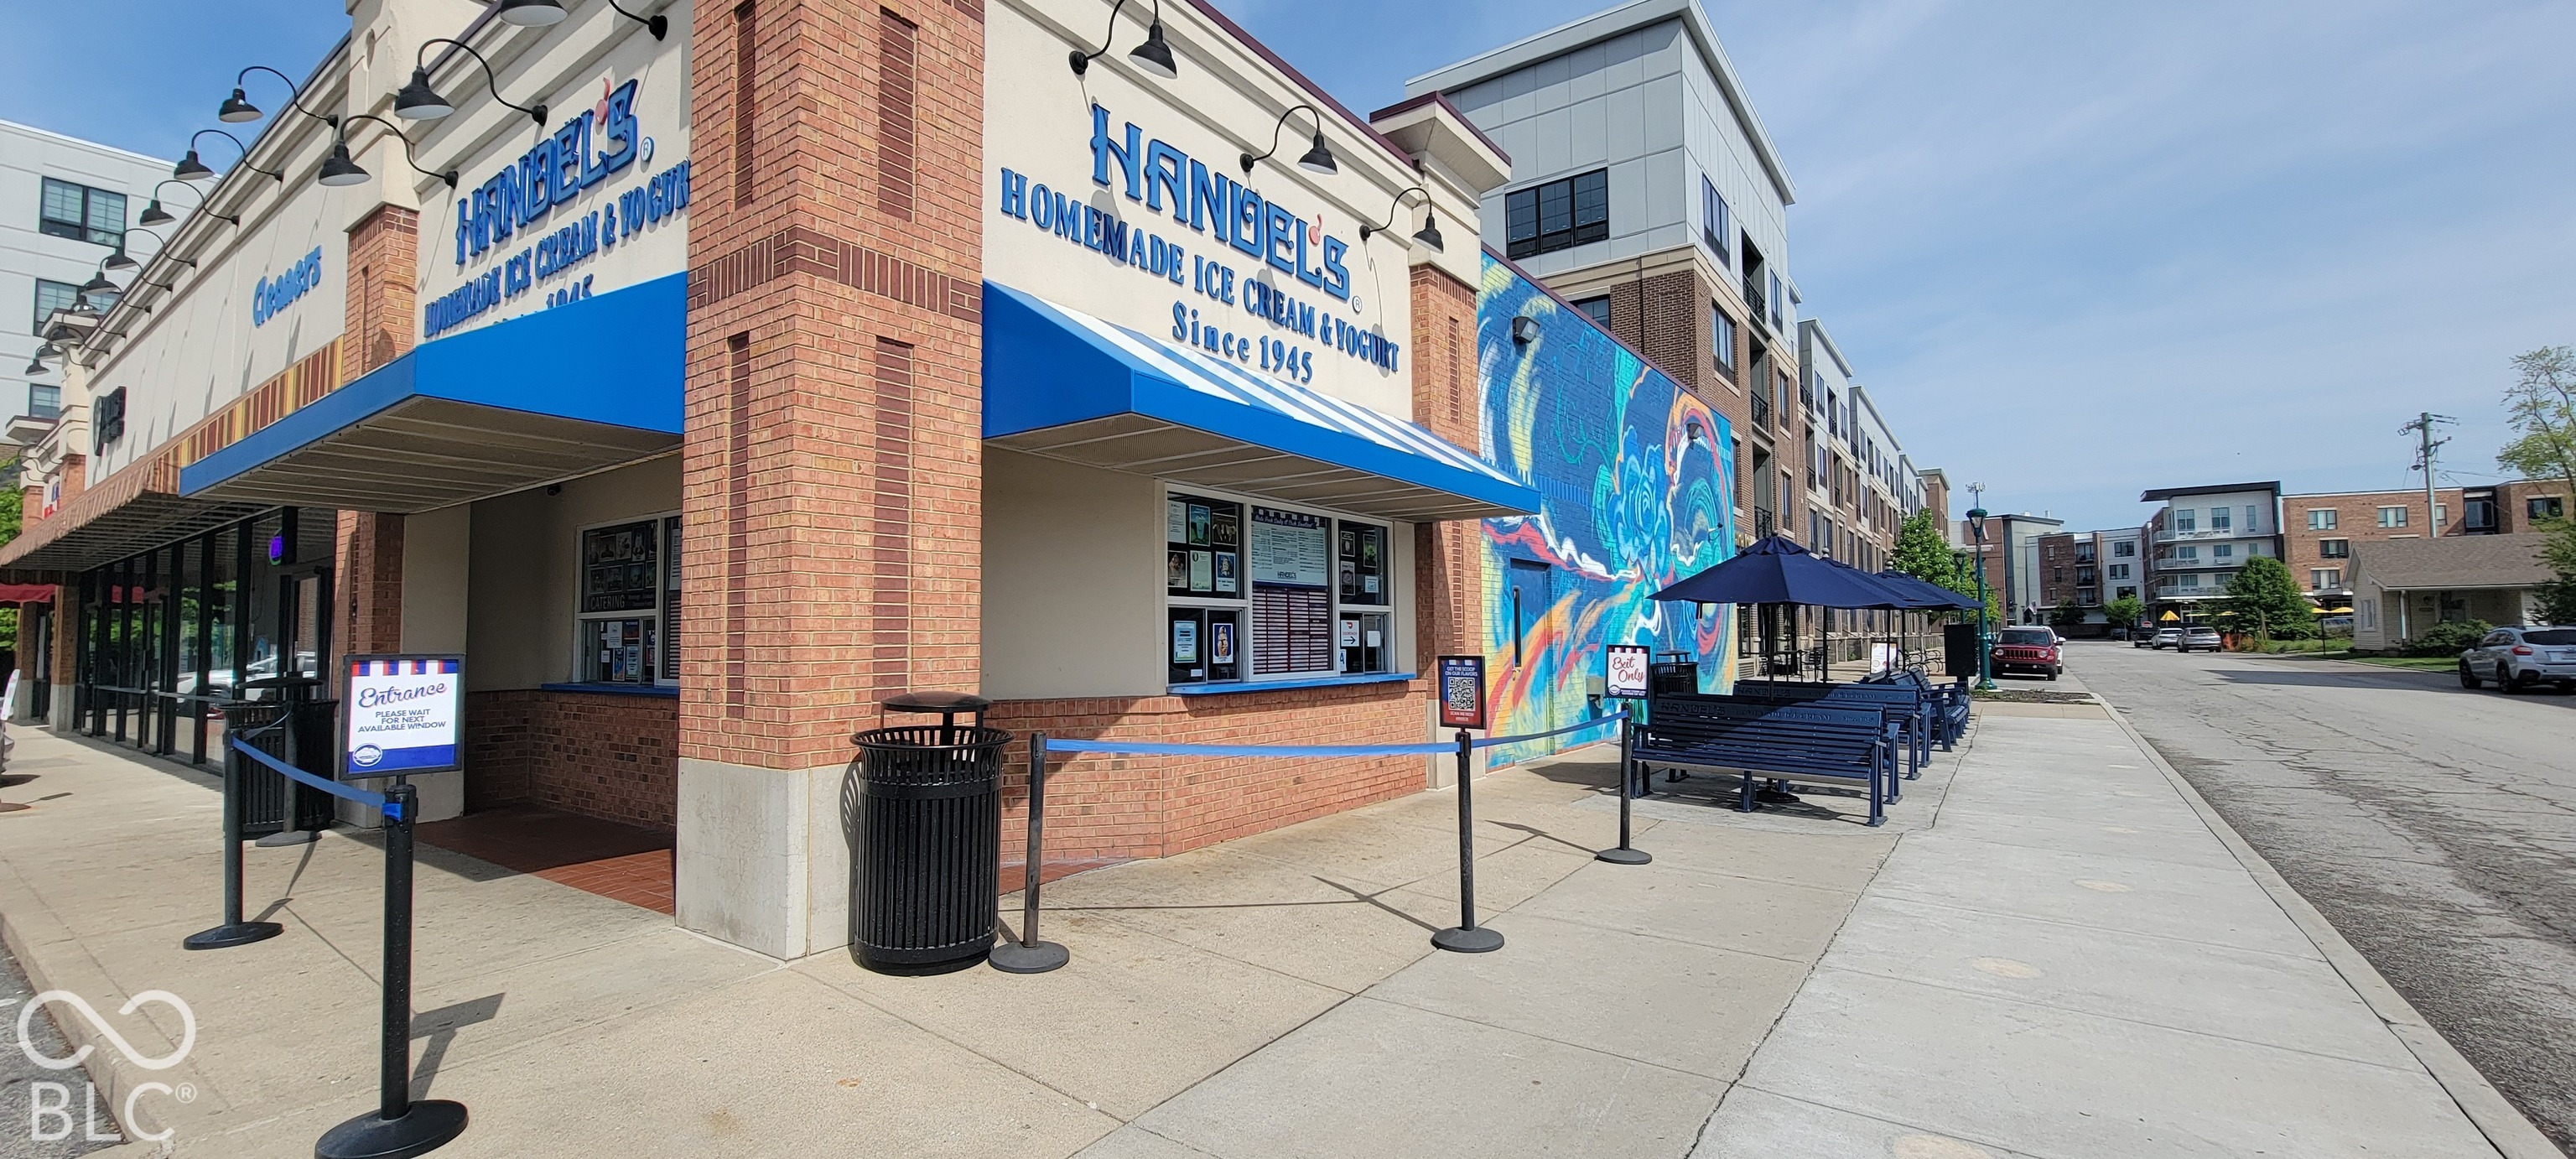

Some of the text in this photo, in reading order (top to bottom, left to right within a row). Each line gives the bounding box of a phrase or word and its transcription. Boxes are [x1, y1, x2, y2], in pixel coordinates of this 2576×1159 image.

[504, 247, 532, 298] ICE
[535, 211, 598, 279] CREAM
[602, 202, 615, 247] &
[619, 157, 691, 237] YOGUR
[1090, 101, 1350, 301] HANDEL'S
[253, 245, 322, 328] Cleaners
[1000, 167, 1400, 373] HOMEMADE ICE CREAM & YOGURT
[1172, 300, 1314, 385] Since 1945
[590, 595, 625, 611] CATERING
[1613, 656, 1636, 670] Exit
[1618, 668, 1644, 683] Only
[358, 683, 447, 709] Entrance
[358, 721, 446, 733] AVAILABLE WINDOW
